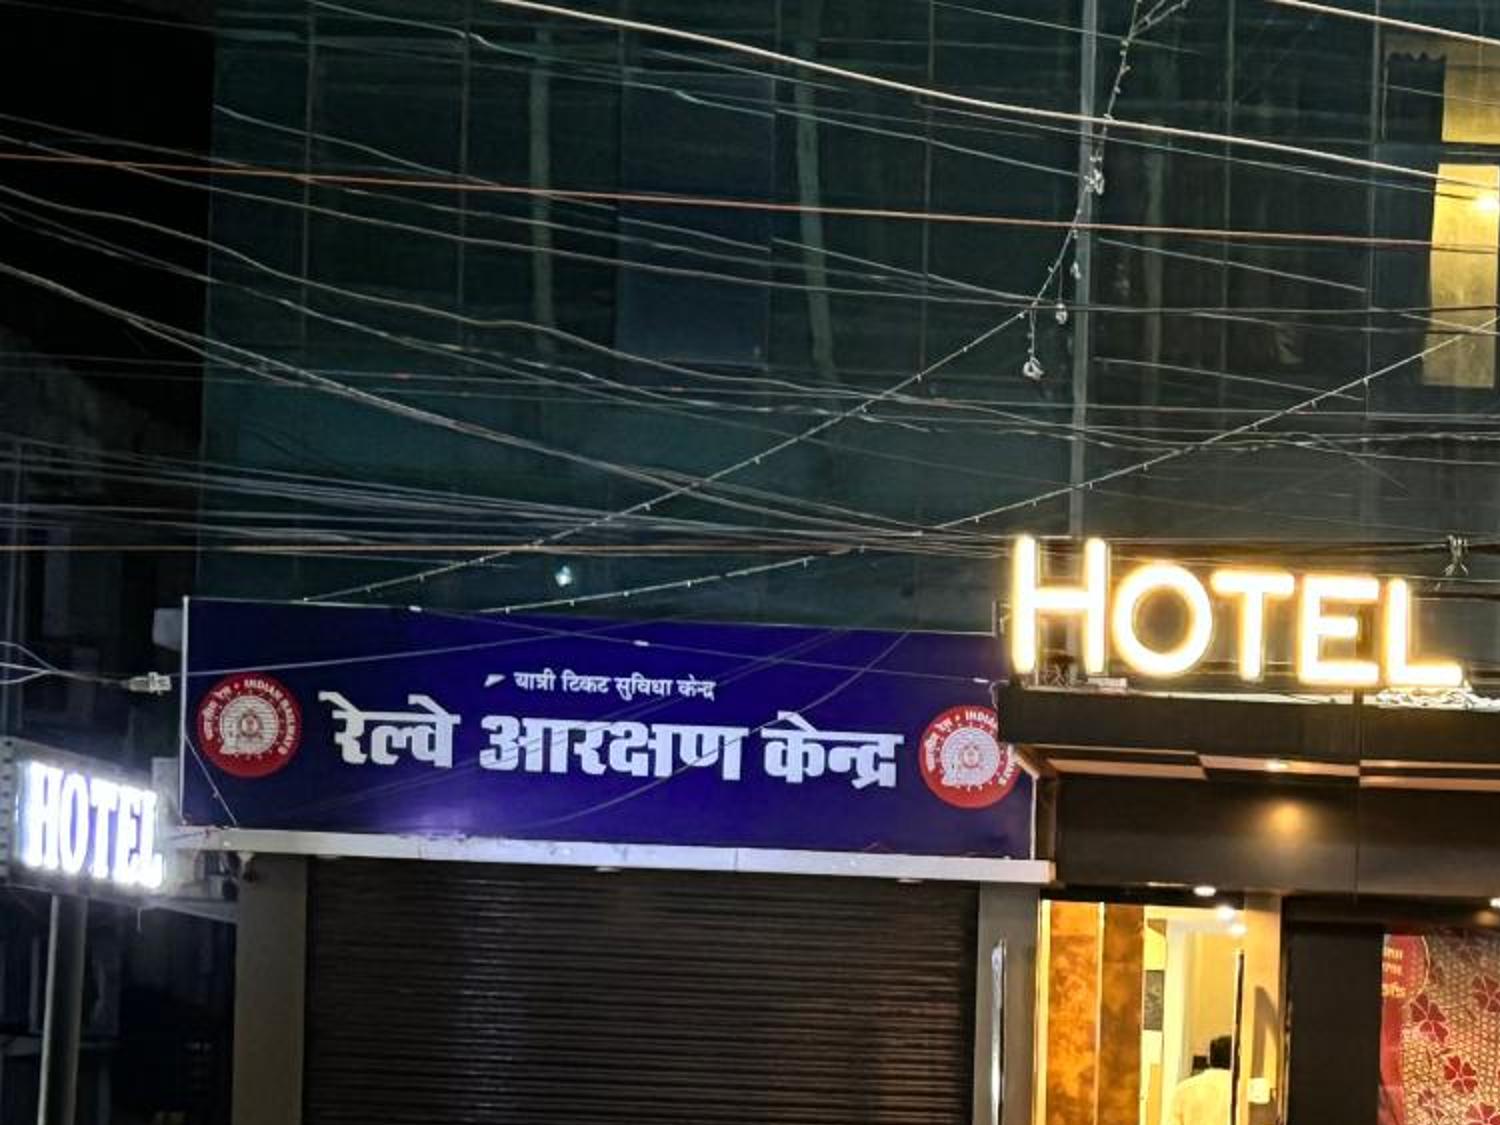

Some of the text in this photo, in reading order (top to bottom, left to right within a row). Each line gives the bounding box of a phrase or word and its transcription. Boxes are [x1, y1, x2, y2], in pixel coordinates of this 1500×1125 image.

[1012, 534, 1464, 686] HOTEL
[318, 691, 905, 790] रेल्वे आरक्षण केन्द्र
[513, 668, 556, 691] यात्री
[561, 669, 611, 693] टिकट
[614, 672, 673, 701] सुविधा
[23, 760, 163, 889] HOTEL
